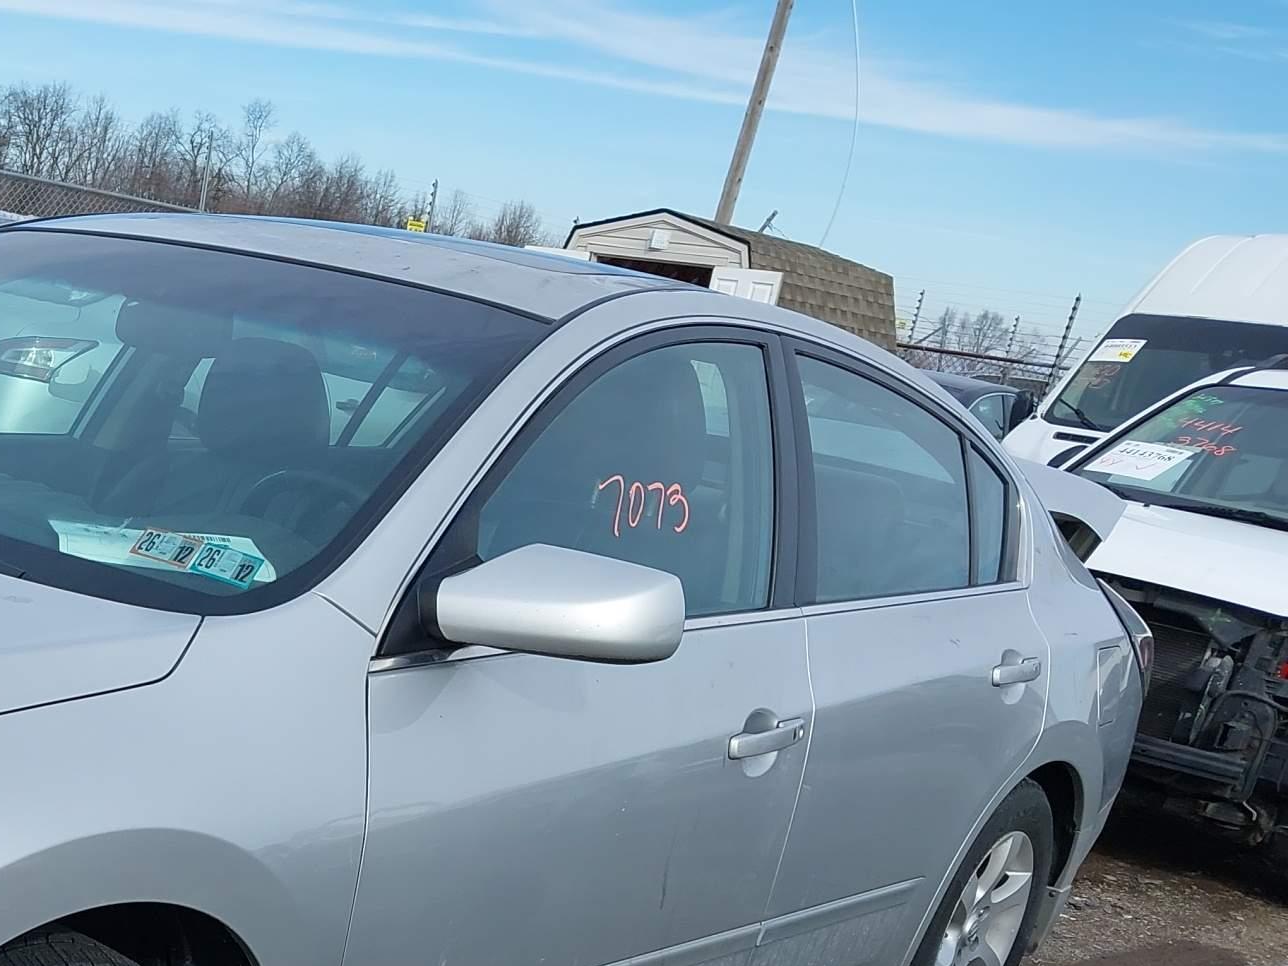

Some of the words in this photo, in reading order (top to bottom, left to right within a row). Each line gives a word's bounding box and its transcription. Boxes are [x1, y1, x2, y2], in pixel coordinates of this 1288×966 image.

[598, 473, 690, 538] 7073
[137, 532, 161, 552] 26
[173, 545, 195, 564] 12
[197, 547, 221, 569] 26
[233, 563, 255, 584] 12
